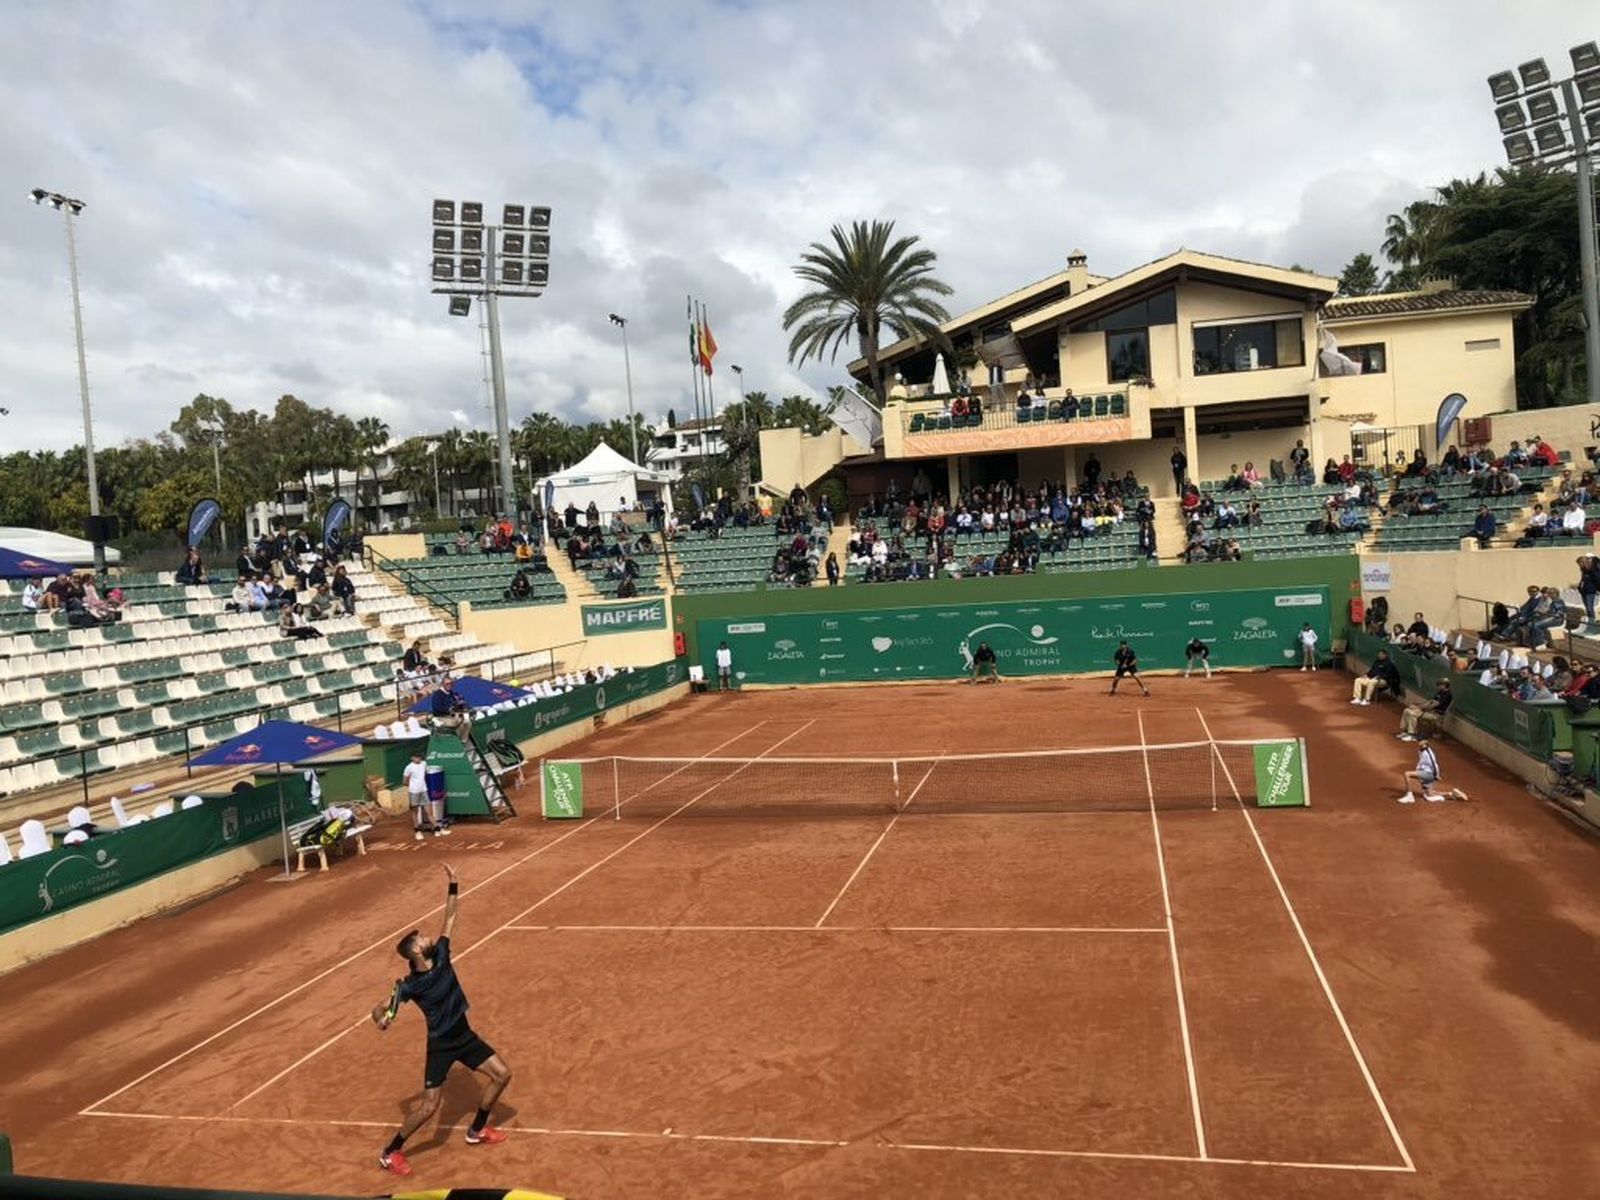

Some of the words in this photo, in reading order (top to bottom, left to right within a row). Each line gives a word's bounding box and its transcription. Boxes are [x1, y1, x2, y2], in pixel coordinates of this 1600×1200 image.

[586, 607, 662, 626] MAPFRE
[1015, 647, 1061, 656] ADMIRAL
[1024, 658, 1061, 667] TROPHY
[1266, 752, 1279, 775] ATP
[1268, 745, 1294, 804] CHALLENGER
[1279, 771, 1293, 797] TOUR
